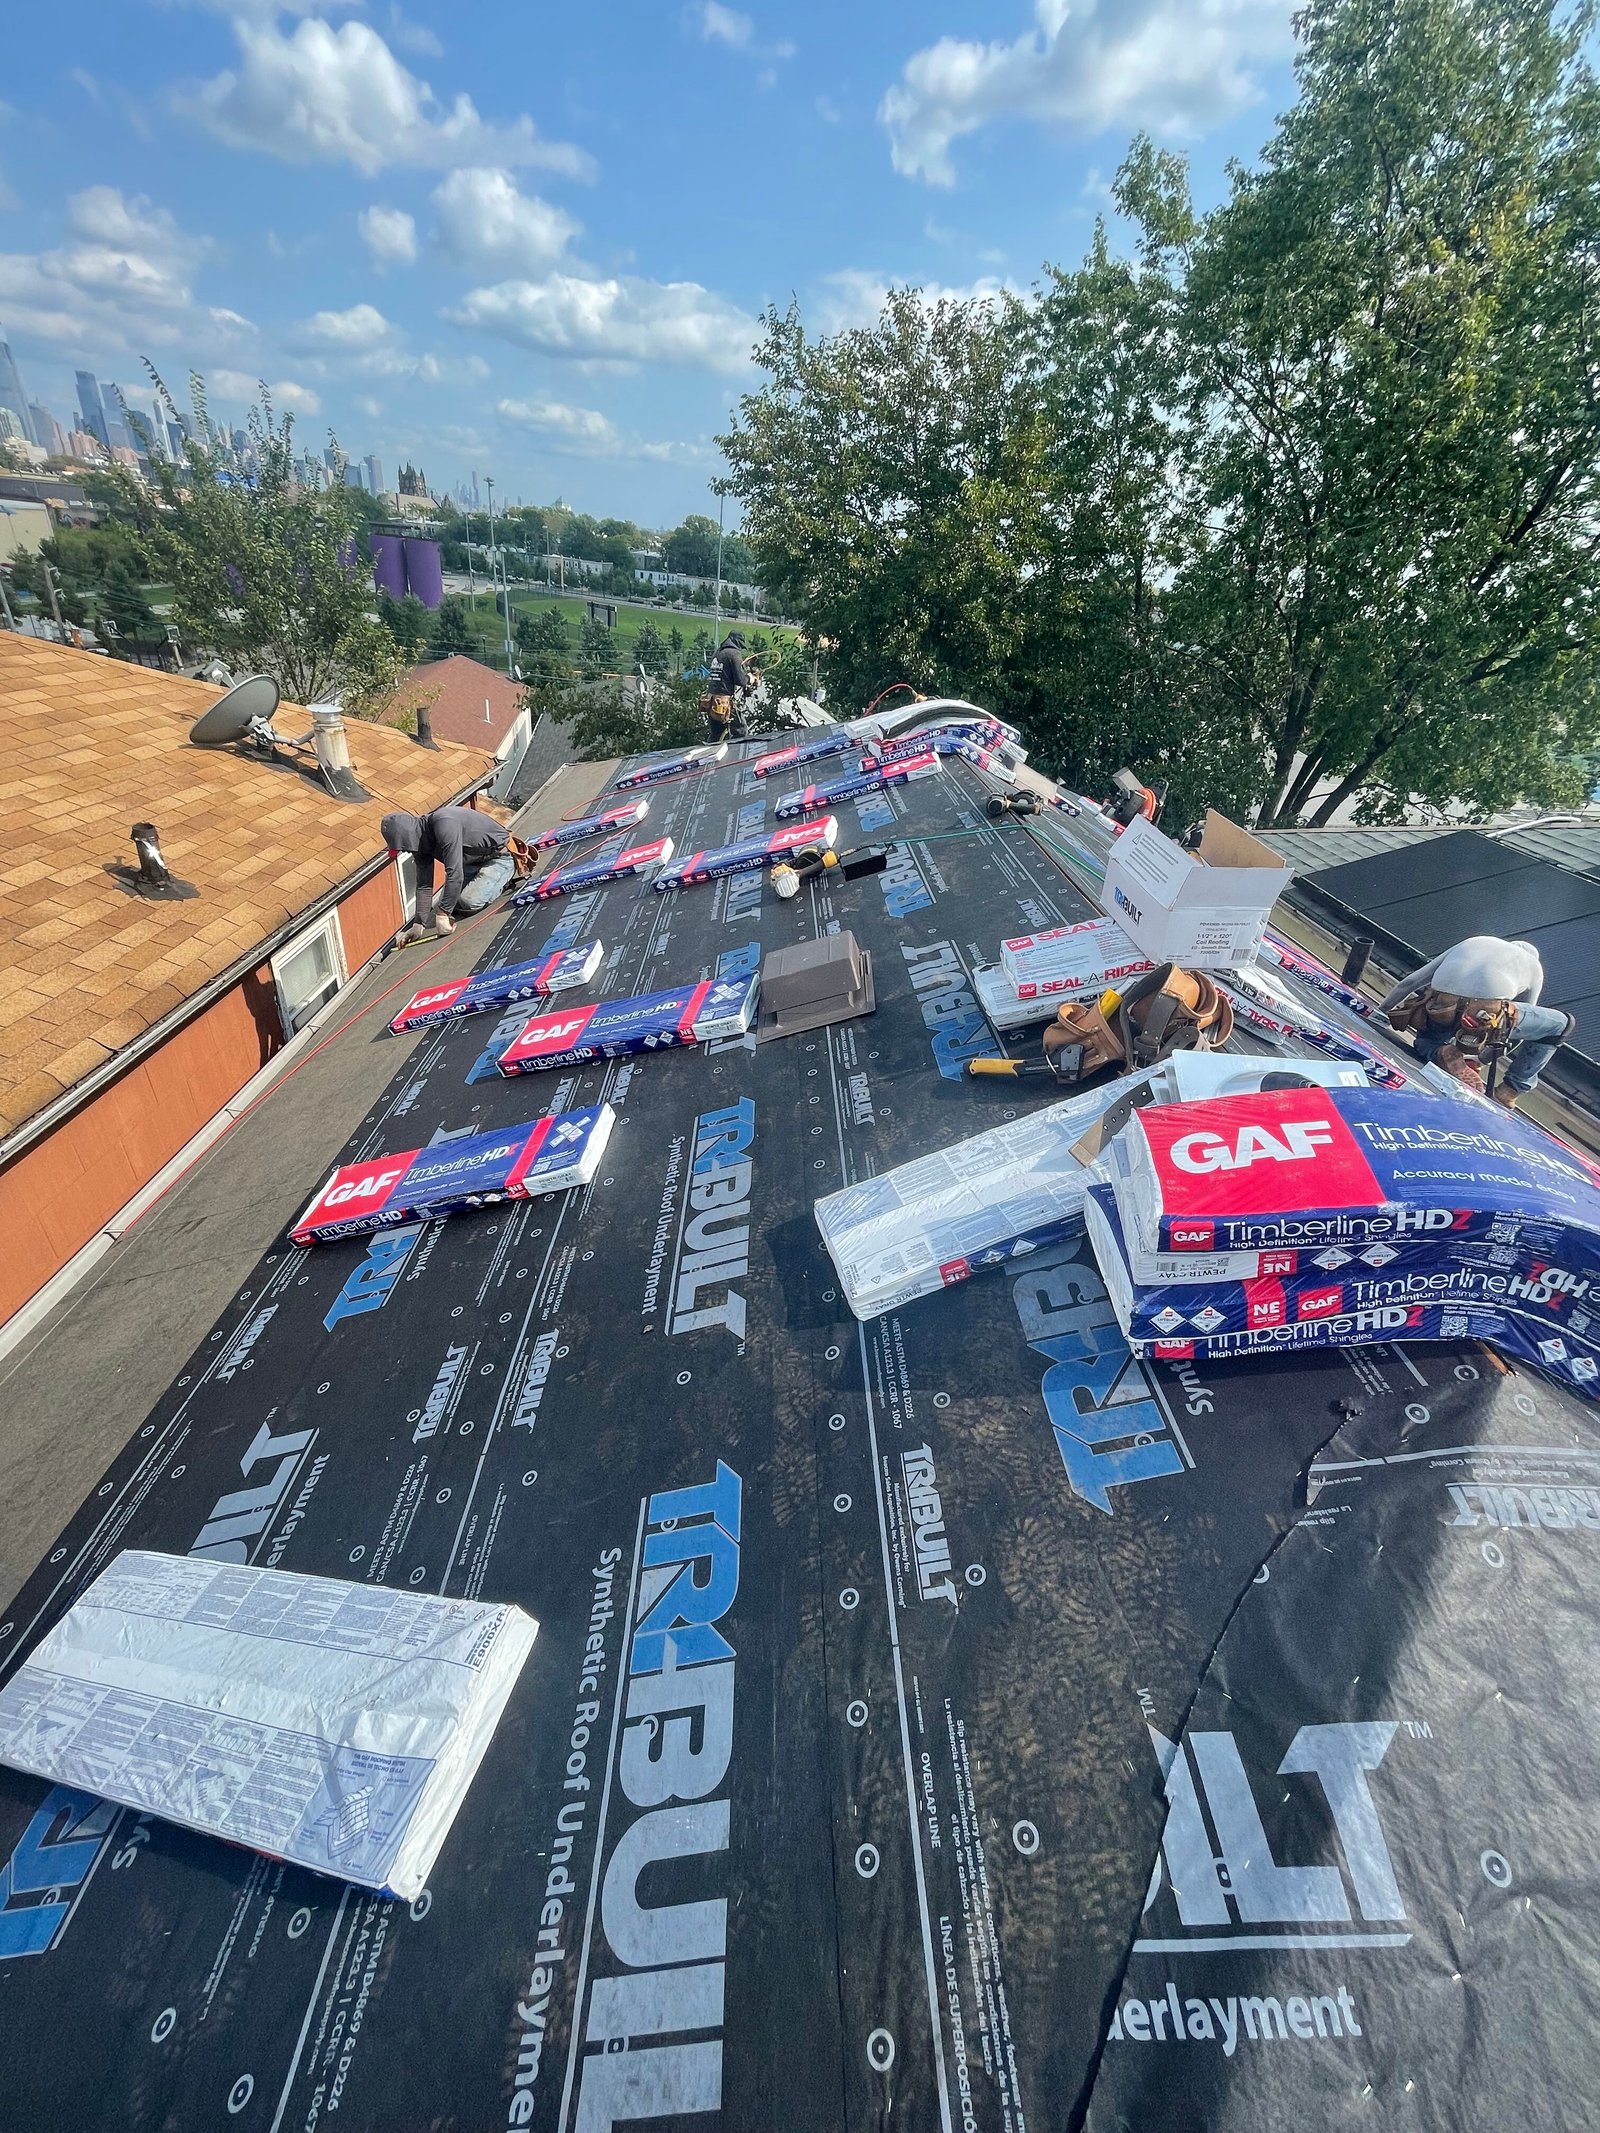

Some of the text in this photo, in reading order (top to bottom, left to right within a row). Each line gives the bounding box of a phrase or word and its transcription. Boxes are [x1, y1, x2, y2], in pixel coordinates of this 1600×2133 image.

[1009, 939, 1030, 948] GAF
[411, 987, 463, 1009] GAF
[1020, 986, 1036, 994] GAF
[520, 1019, 585, 1046] GAF
[1170, 1120, 1334, 1174] GAF
[1373, 1142, 1403, 1151] High
[325, 1169, 402, 1206] GAF
[1393, 1169, 1577, 1203] Accuracy made easy
[642, 1135, 685, 1314] Synthetic Roof Underlayment
[672, 1096, 755, 1341] TRIBUILT
[1173, 1231, 1211, 1242] GAF
[1230, 1241, 1255, 1249] High
[406, 1226, 443, 1282] Synthetic
[1263, 1262, 1290, 1273] NE
[1254, 1301, 1280, 1316] NE
[1301, 1295, 1339, 1311] GAF
[1357, 1298, 1383, 1310] High
[880, 1316, 891, 1348] CAN/CSA
[892, 1317, 902, 1341] MEETS
[1208, 1349, 1232, 1358] High
[1329, 1332, 1373, 1344] Shingles
[895, 1342, 906, 1365] ASTM
[512, 1328, 559, 1430] TRIBUILT
[888, 1381, 898, 1404] CCRR
[898, 1365, 910, 1389] D4869
[412, 1344, 467, 1444] TRIBUILT
[903, 1396, 915, 1419] D226
[892, 1408, 902, 1429] 1067
[266, 1453, 331, 1568] erlayment
[894, 1482, 905, 1525] Manufactured
[904, 1441, 958, 1607] TRIBUILT
[367, 1547, 384, 1578] MEETS
[380, 1520, 395, 1545] ASTM
[376, 1539, 397, 1582] CAN/CSA
[582, 1547, 622, 1693] Synthetic
[562, 1699, 600, 1795] Roof
[959, 1742, 971, 1788] resistance
[921, 1752, 941, 1848] OVERLAP LINE
[967, 1789, 976, 1813] may
[952, 1826, 961, 1847] tipo
[970, 1814, 980, 1838] vary
[956, 1849, 964, 1863] de
[975, 1839, 985, 1863] with
[946, 1711, 957, 1761] resistencia
[955, 1773, 970, 1844] deslizamiento
[964, 1845, 976, 1880] puede
[971, 1881, 982, 1917] variar
[986, 1984, 1003, 2066] condiciones
[998, 2070, 1008, 2088] de
[957, 1865, 970, 1910] calzado
[979, 1865, 992, 1909] surface
[940, 1916, 955, 1966] LÍNEA
[945, 1968, 959, 1992] DE
[968, 1937, 984, 2008] inclinación
[328, 1916, 389, 2112] ASTM D4869 & D226
[978, 2011, 988, 2032] del
[323, 2011, 346, 2067] CCRR
[981, 2036, 993, 2076] techo
[1006, 2043, 1021, 2108] footwear
